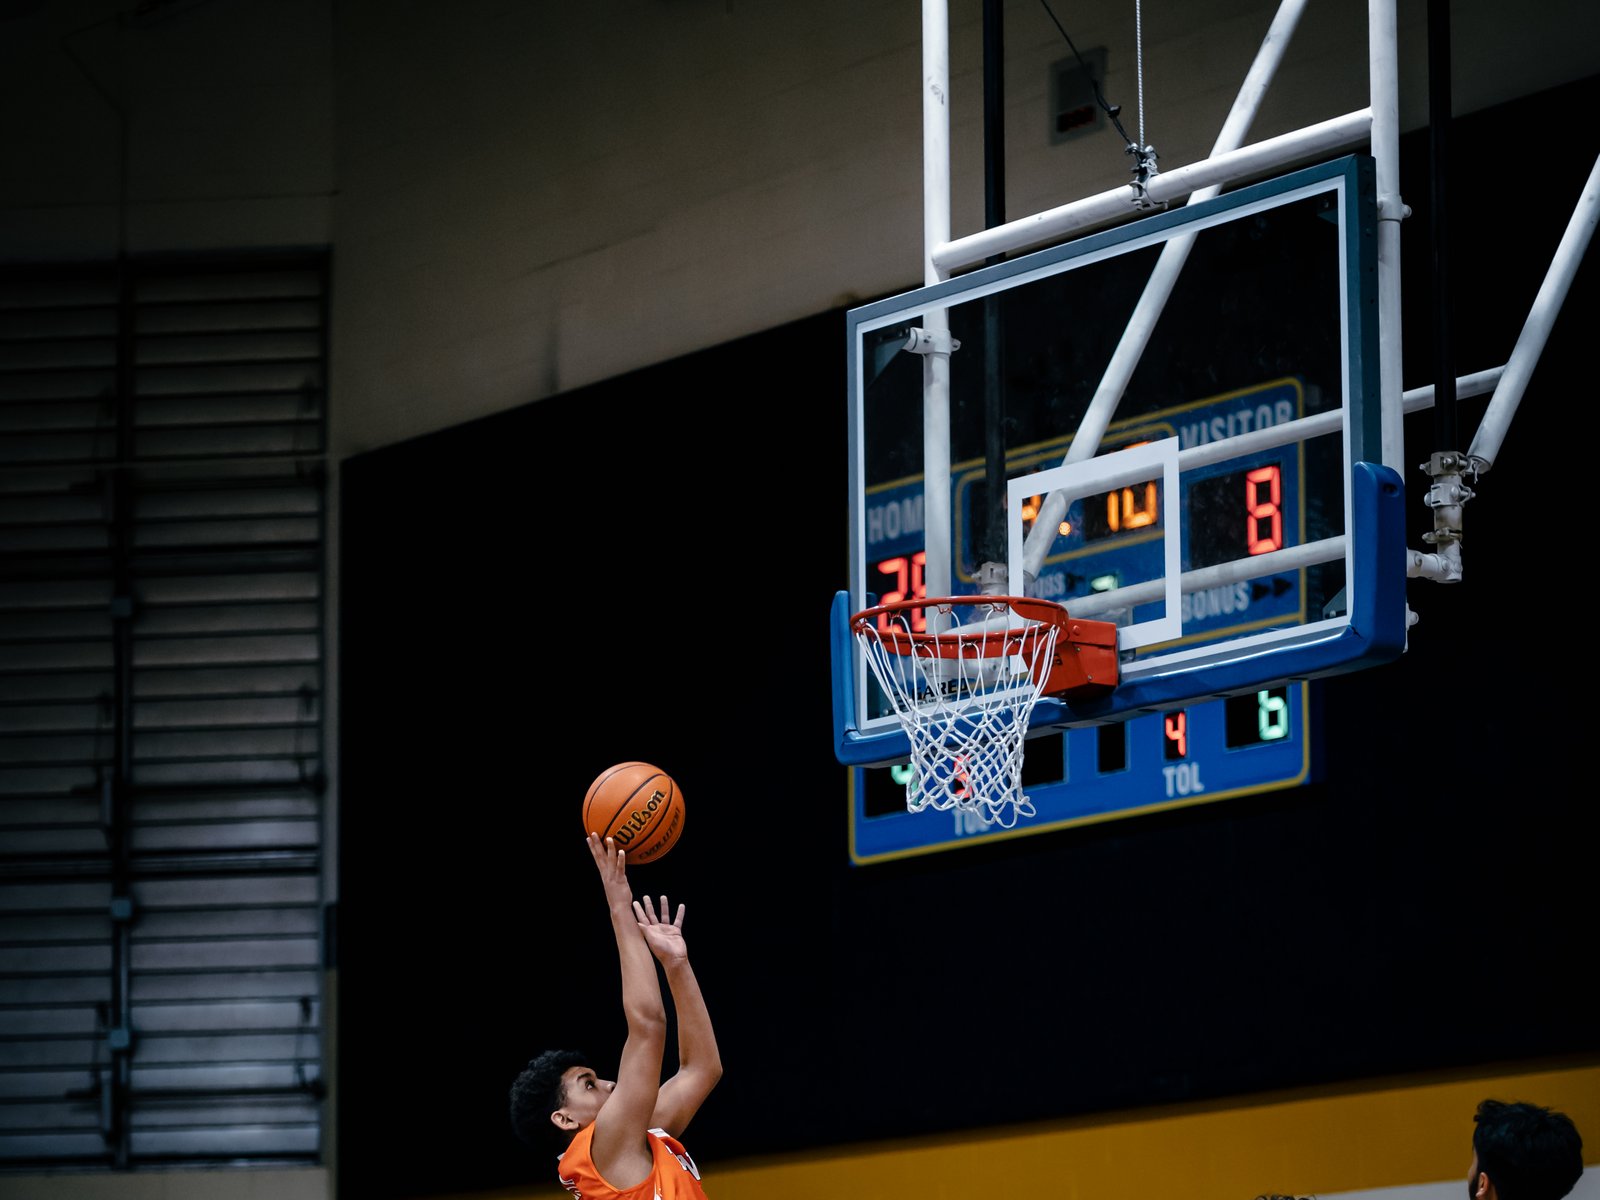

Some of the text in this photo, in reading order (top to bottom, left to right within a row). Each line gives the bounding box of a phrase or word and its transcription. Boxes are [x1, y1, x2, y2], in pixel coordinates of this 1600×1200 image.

[1180, 400, 1294, 449] VISITOR
[868, 494, 925, 544] HOM
[1246, 465, 1283, 556] 8
[1165, 711, 1186, 756] 4
[1162, 761, 1205, 798] TOL
[613, 789, 665, 845] Wilson
